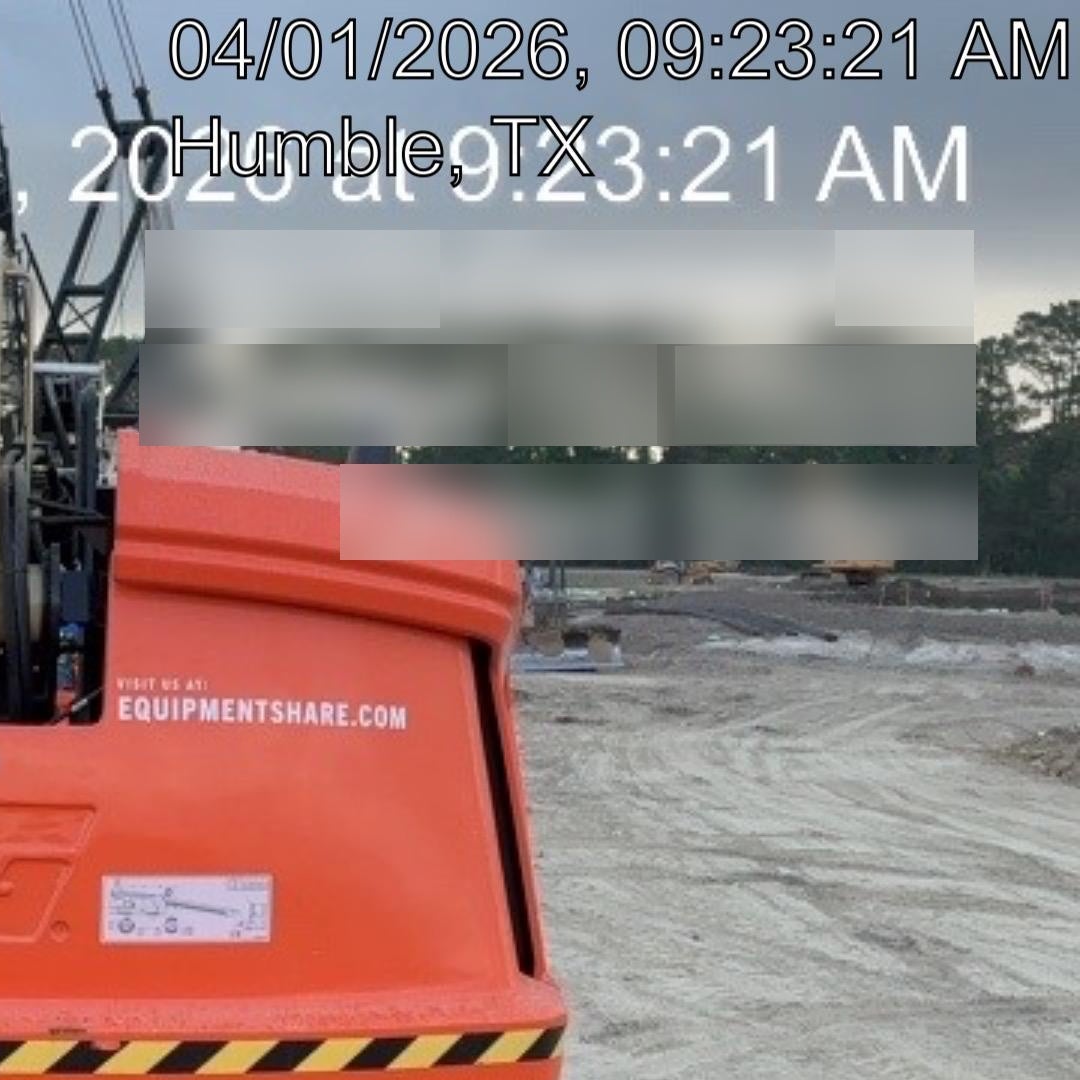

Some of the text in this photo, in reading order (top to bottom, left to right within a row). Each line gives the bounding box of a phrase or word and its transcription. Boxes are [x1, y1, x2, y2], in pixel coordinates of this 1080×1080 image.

[117, 678, 155, 691] VISIT
[161, 679, 179, 691] US
[119, 695, 407, 729] EQUIPMENTSHARE.COM
